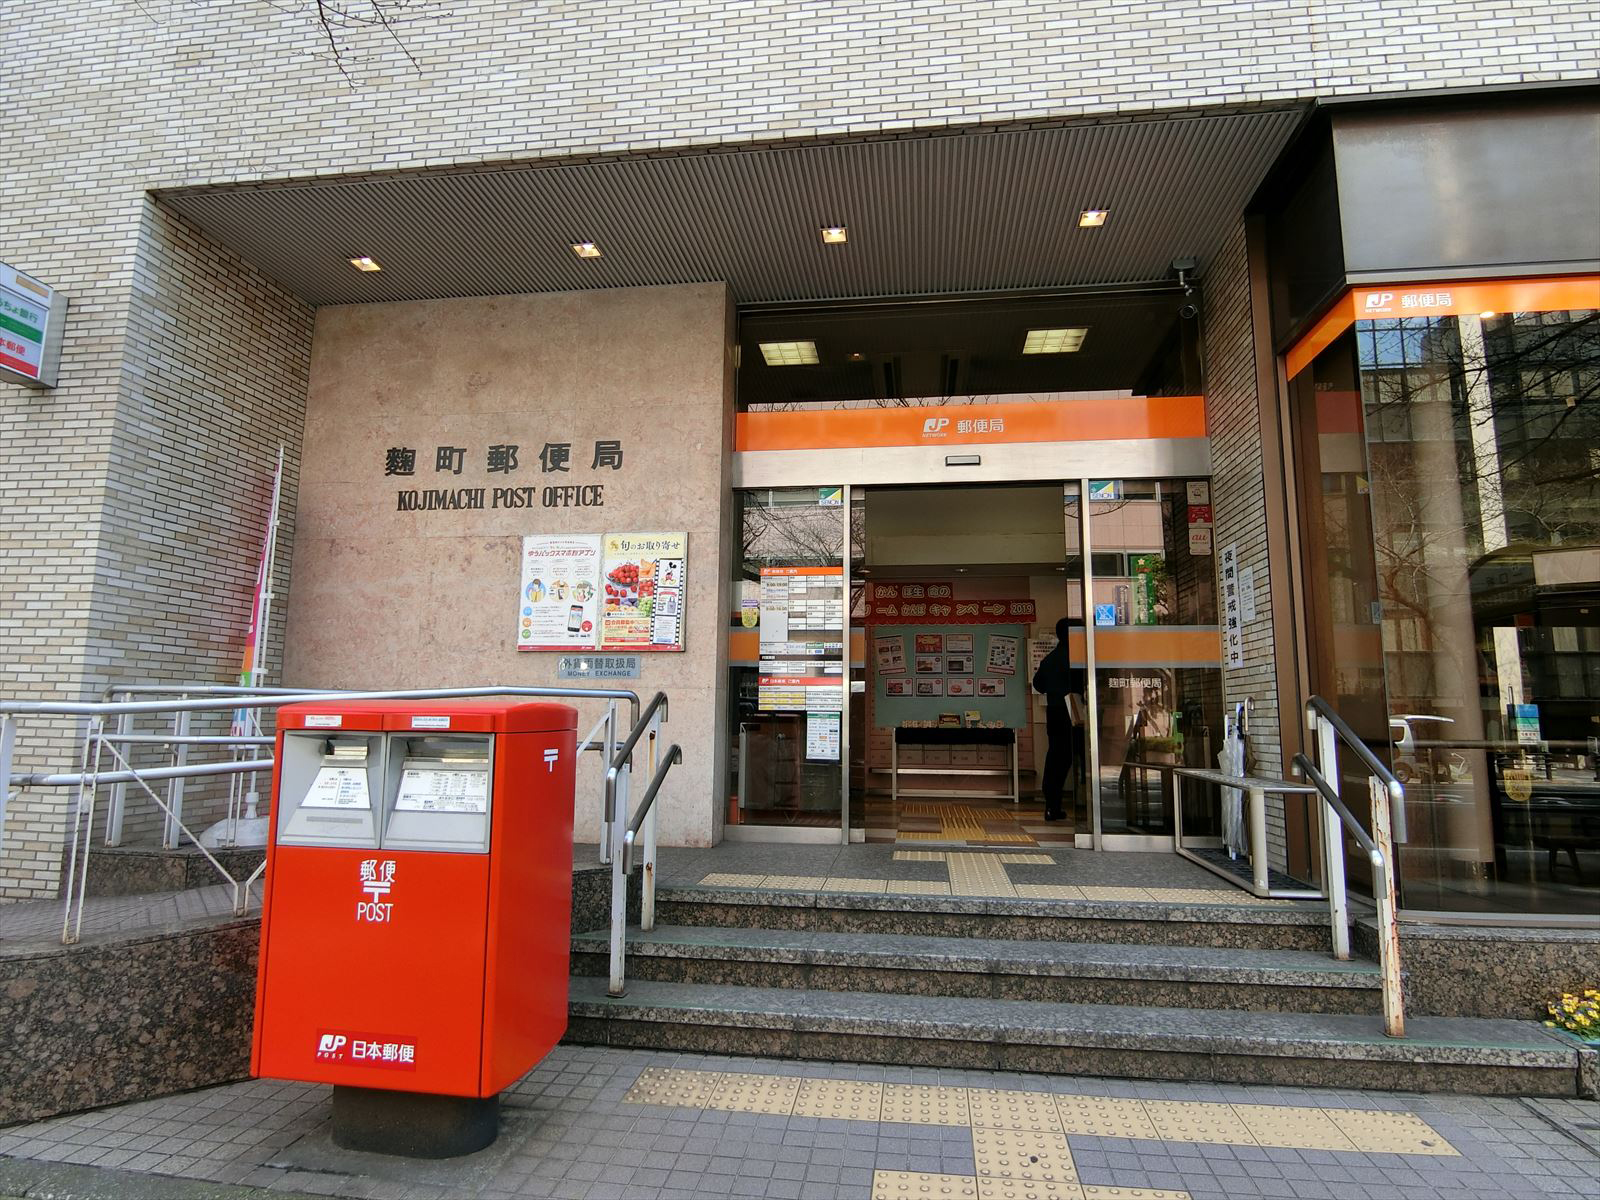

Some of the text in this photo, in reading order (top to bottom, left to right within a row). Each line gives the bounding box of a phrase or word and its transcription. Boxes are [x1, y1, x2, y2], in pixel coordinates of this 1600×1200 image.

[1401, 293, 1452, 308] 郵便局
[957, 418, 1004, 434] 郵便局
[397, 485, 604, 511] KOJIMACHI POST OFFICE
[1224, 549, 1239, 663] 夜間警戒強化中
[360, 859, 396, 882] 郵便
[357, 901, 394, 922] POST
[352, 1040, 415, 1063] 日本郵便
